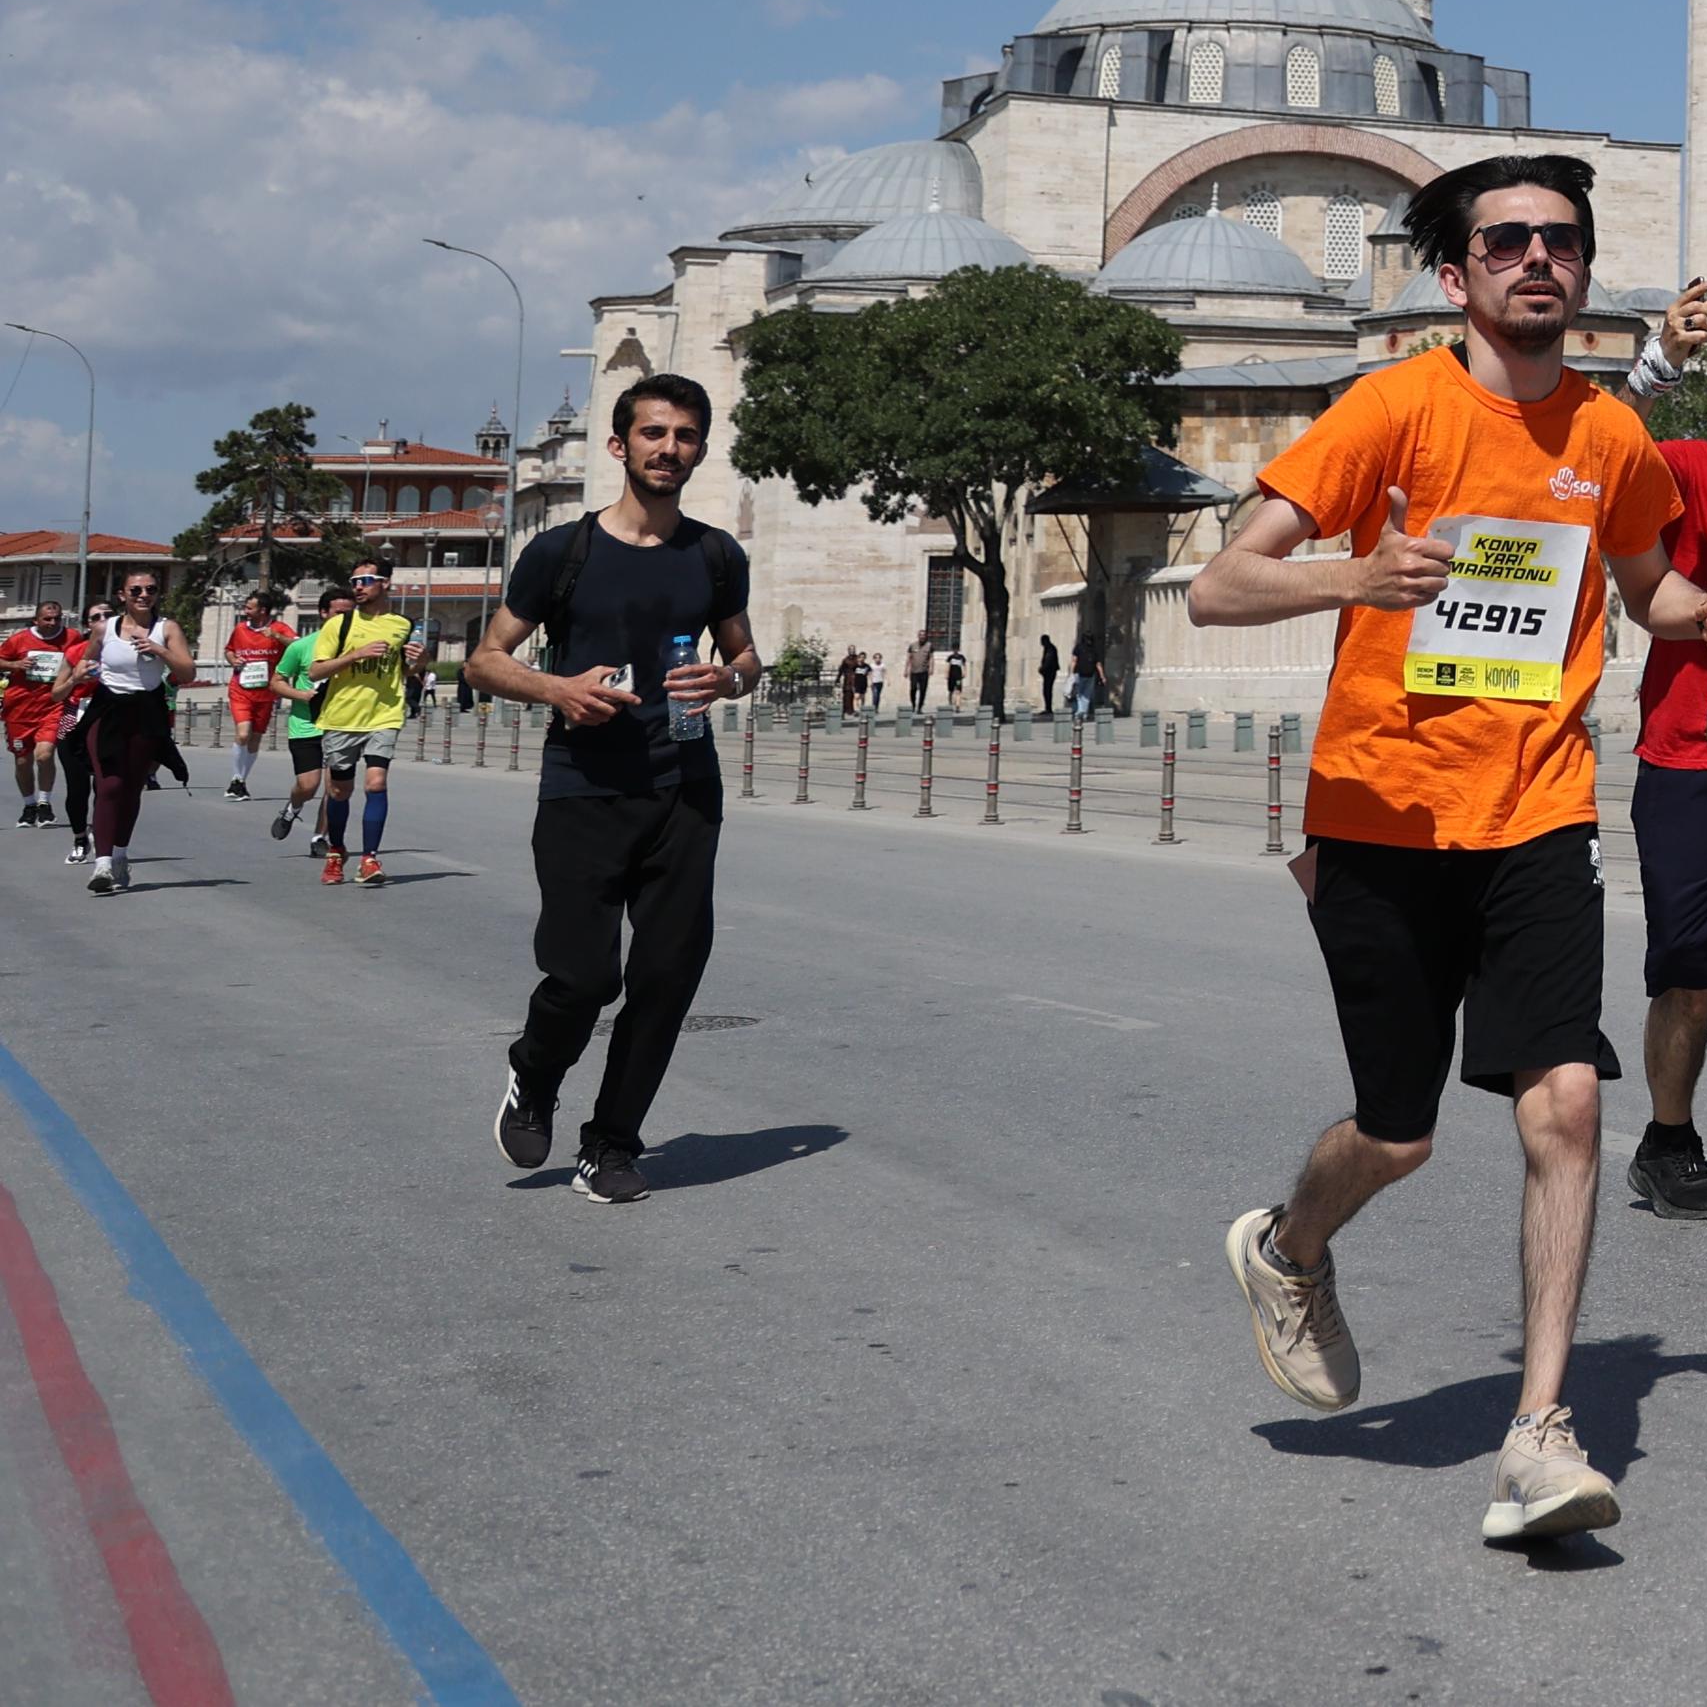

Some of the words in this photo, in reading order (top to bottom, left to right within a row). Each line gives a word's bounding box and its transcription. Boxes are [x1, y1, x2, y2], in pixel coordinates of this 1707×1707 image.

[1475, 537, 1538, 554] KONYA
[1484, 551, 1525, 566] YARI
[1449, 560, 1552, 582] MARATONU
[1436, 600, 1547, 636] 42915
